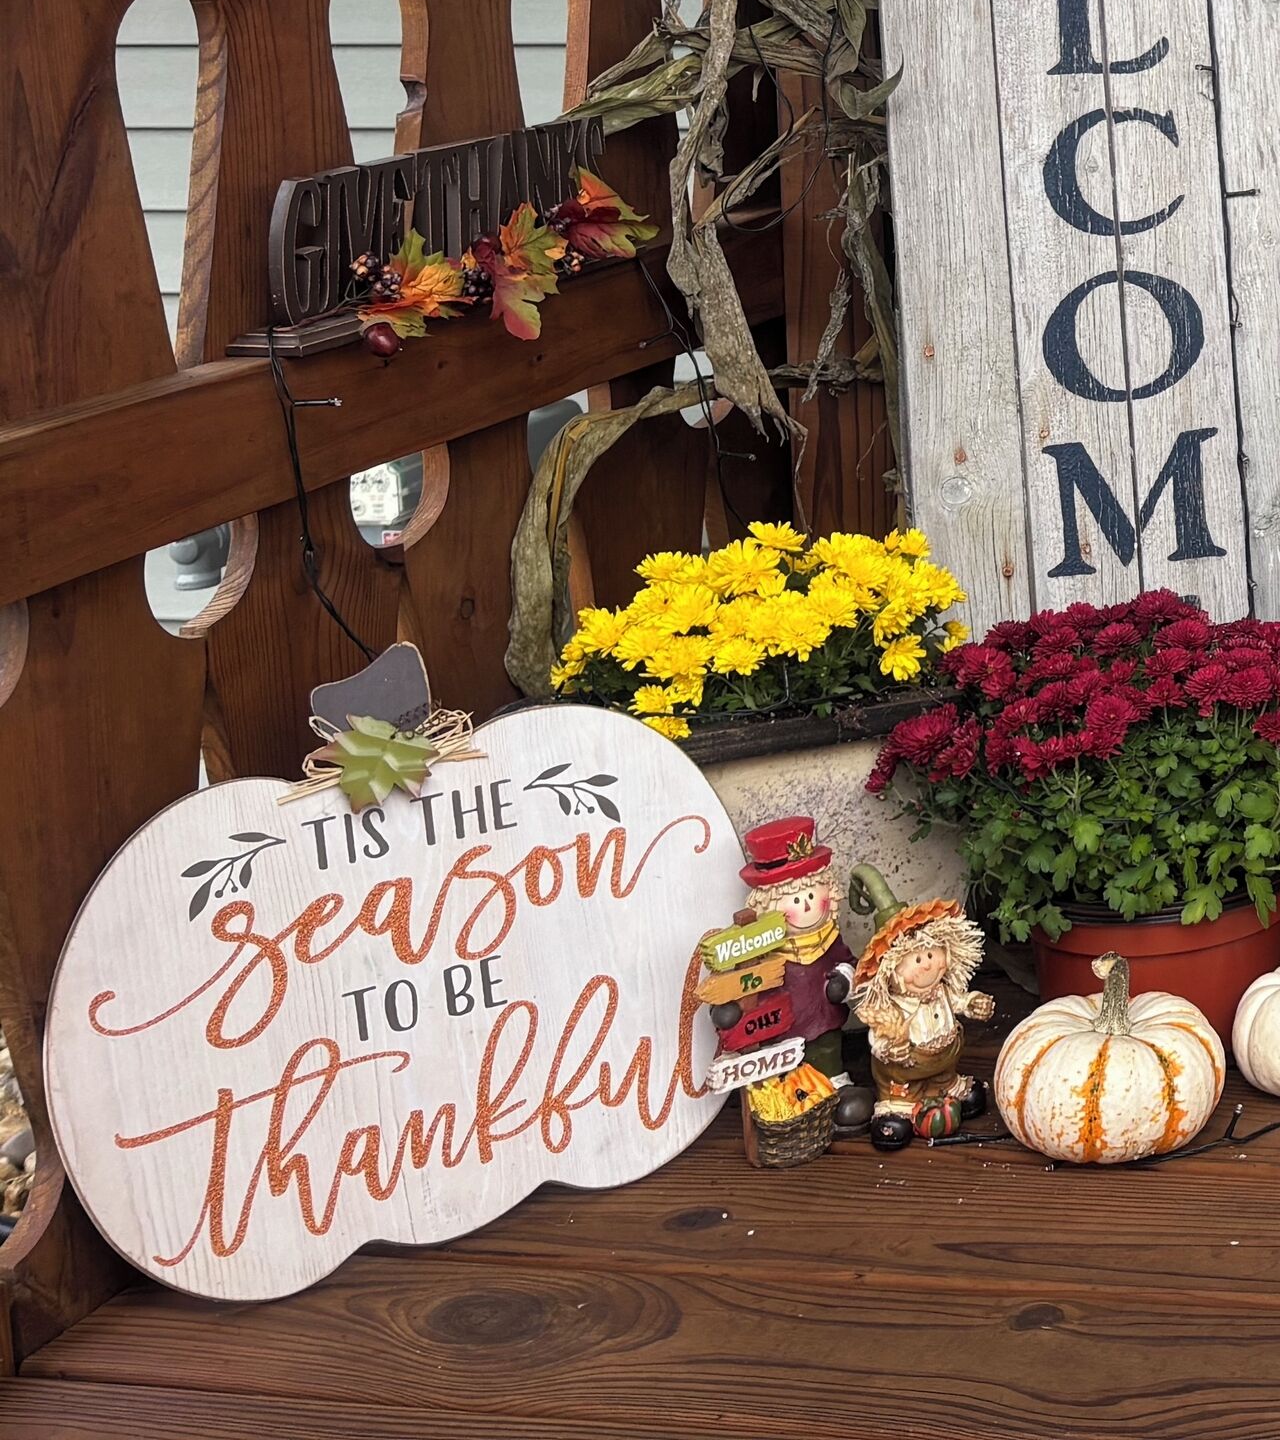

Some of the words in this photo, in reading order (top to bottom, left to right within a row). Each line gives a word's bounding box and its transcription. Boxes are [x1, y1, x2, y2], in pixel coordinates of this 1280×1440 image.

[269, 149, 417, 326] GIVE
[300, 806, 390, 870] TIS
[410, 779, 518, 847] THE
[89, 815, 711, 1049] season
[715, 925, 785, 963] Welcome
[342, 979, 418, 1042] TO
[444, 955, 508, 1018] BE
[740, 971, 763, 992] To
[114, 928, 722, 1267] thankful
[721, 1047, 797, 1084] HOME
